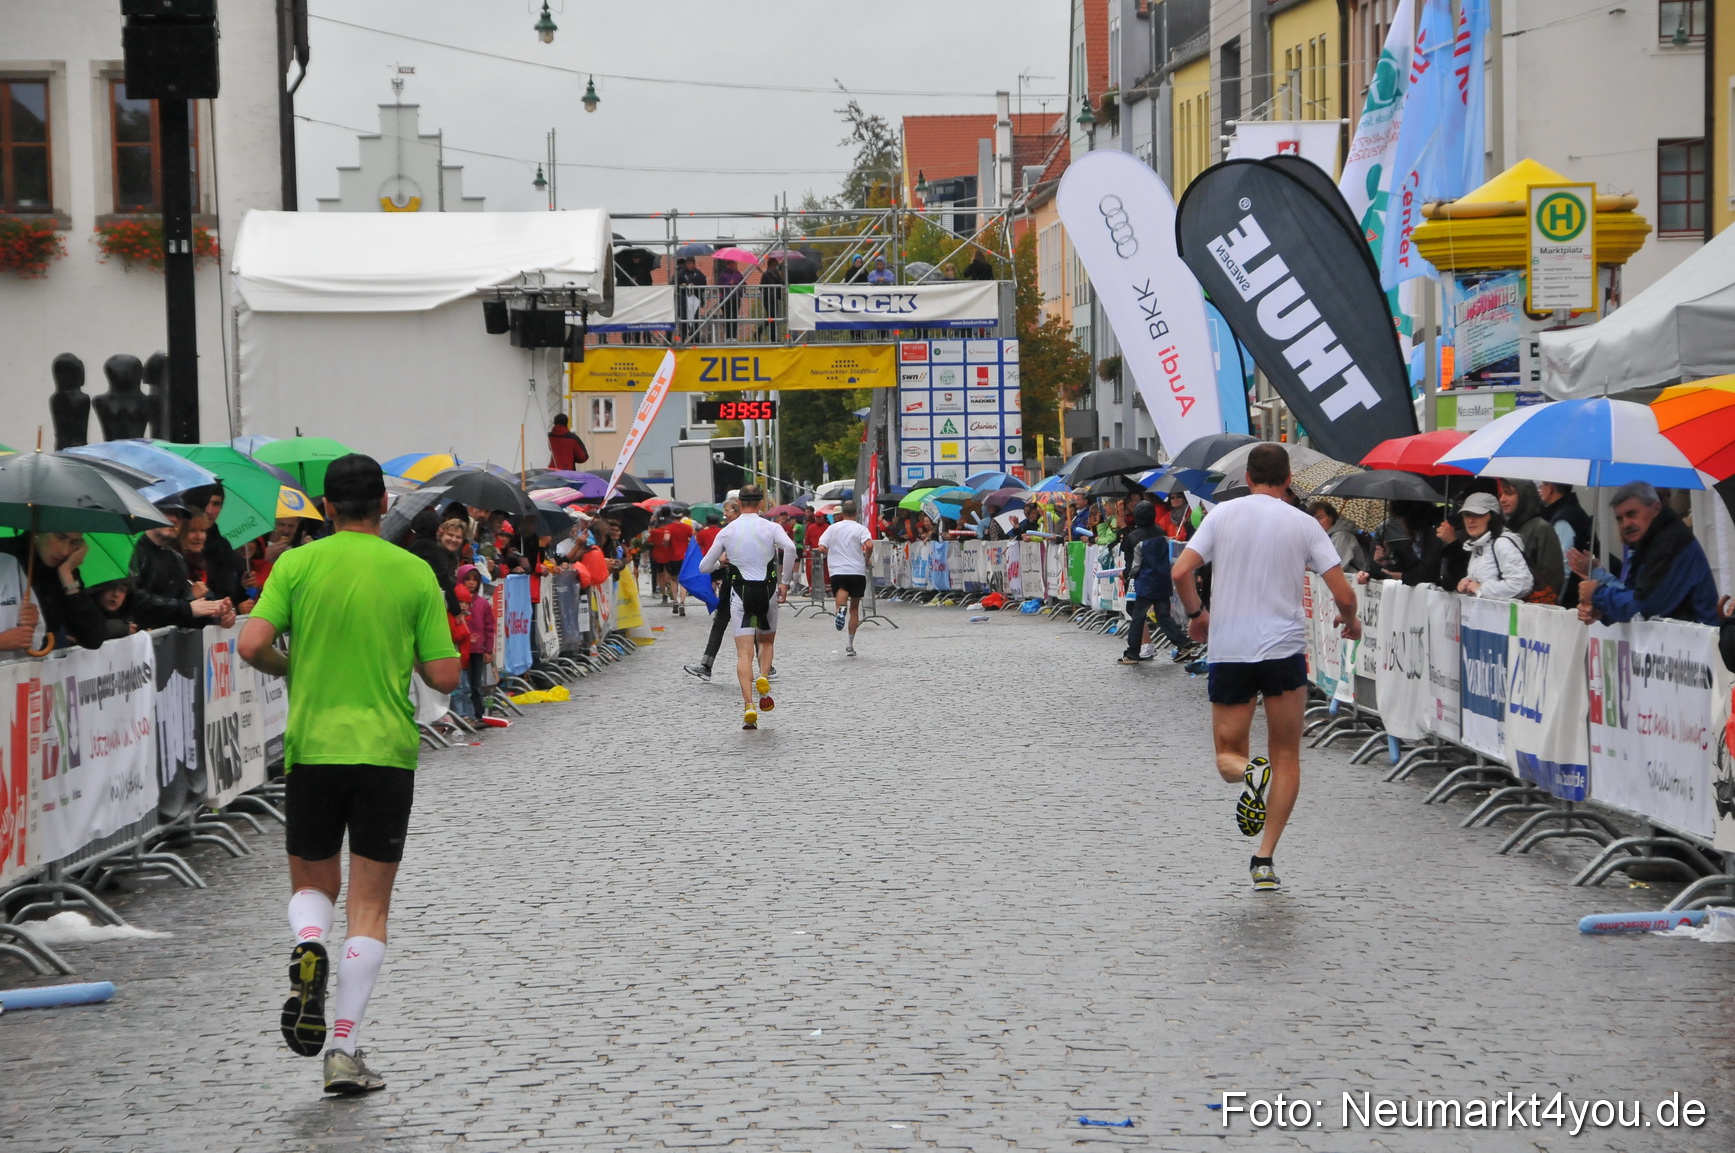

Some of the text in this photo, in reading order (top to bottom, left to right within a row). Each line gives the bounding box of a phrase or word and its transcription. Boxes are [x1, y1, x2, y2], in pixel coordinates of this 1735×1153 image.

[1549, 203, 1573, 231] H
[1540, 247, 1583, 255] Marktplatz
[815, 294, 918, 313] BOCK
[699, 356, 772, 383] ZIEL
[850, 367, 879, 375] Stadtlauf
[719, 402, 772, 419] 1:39:55
